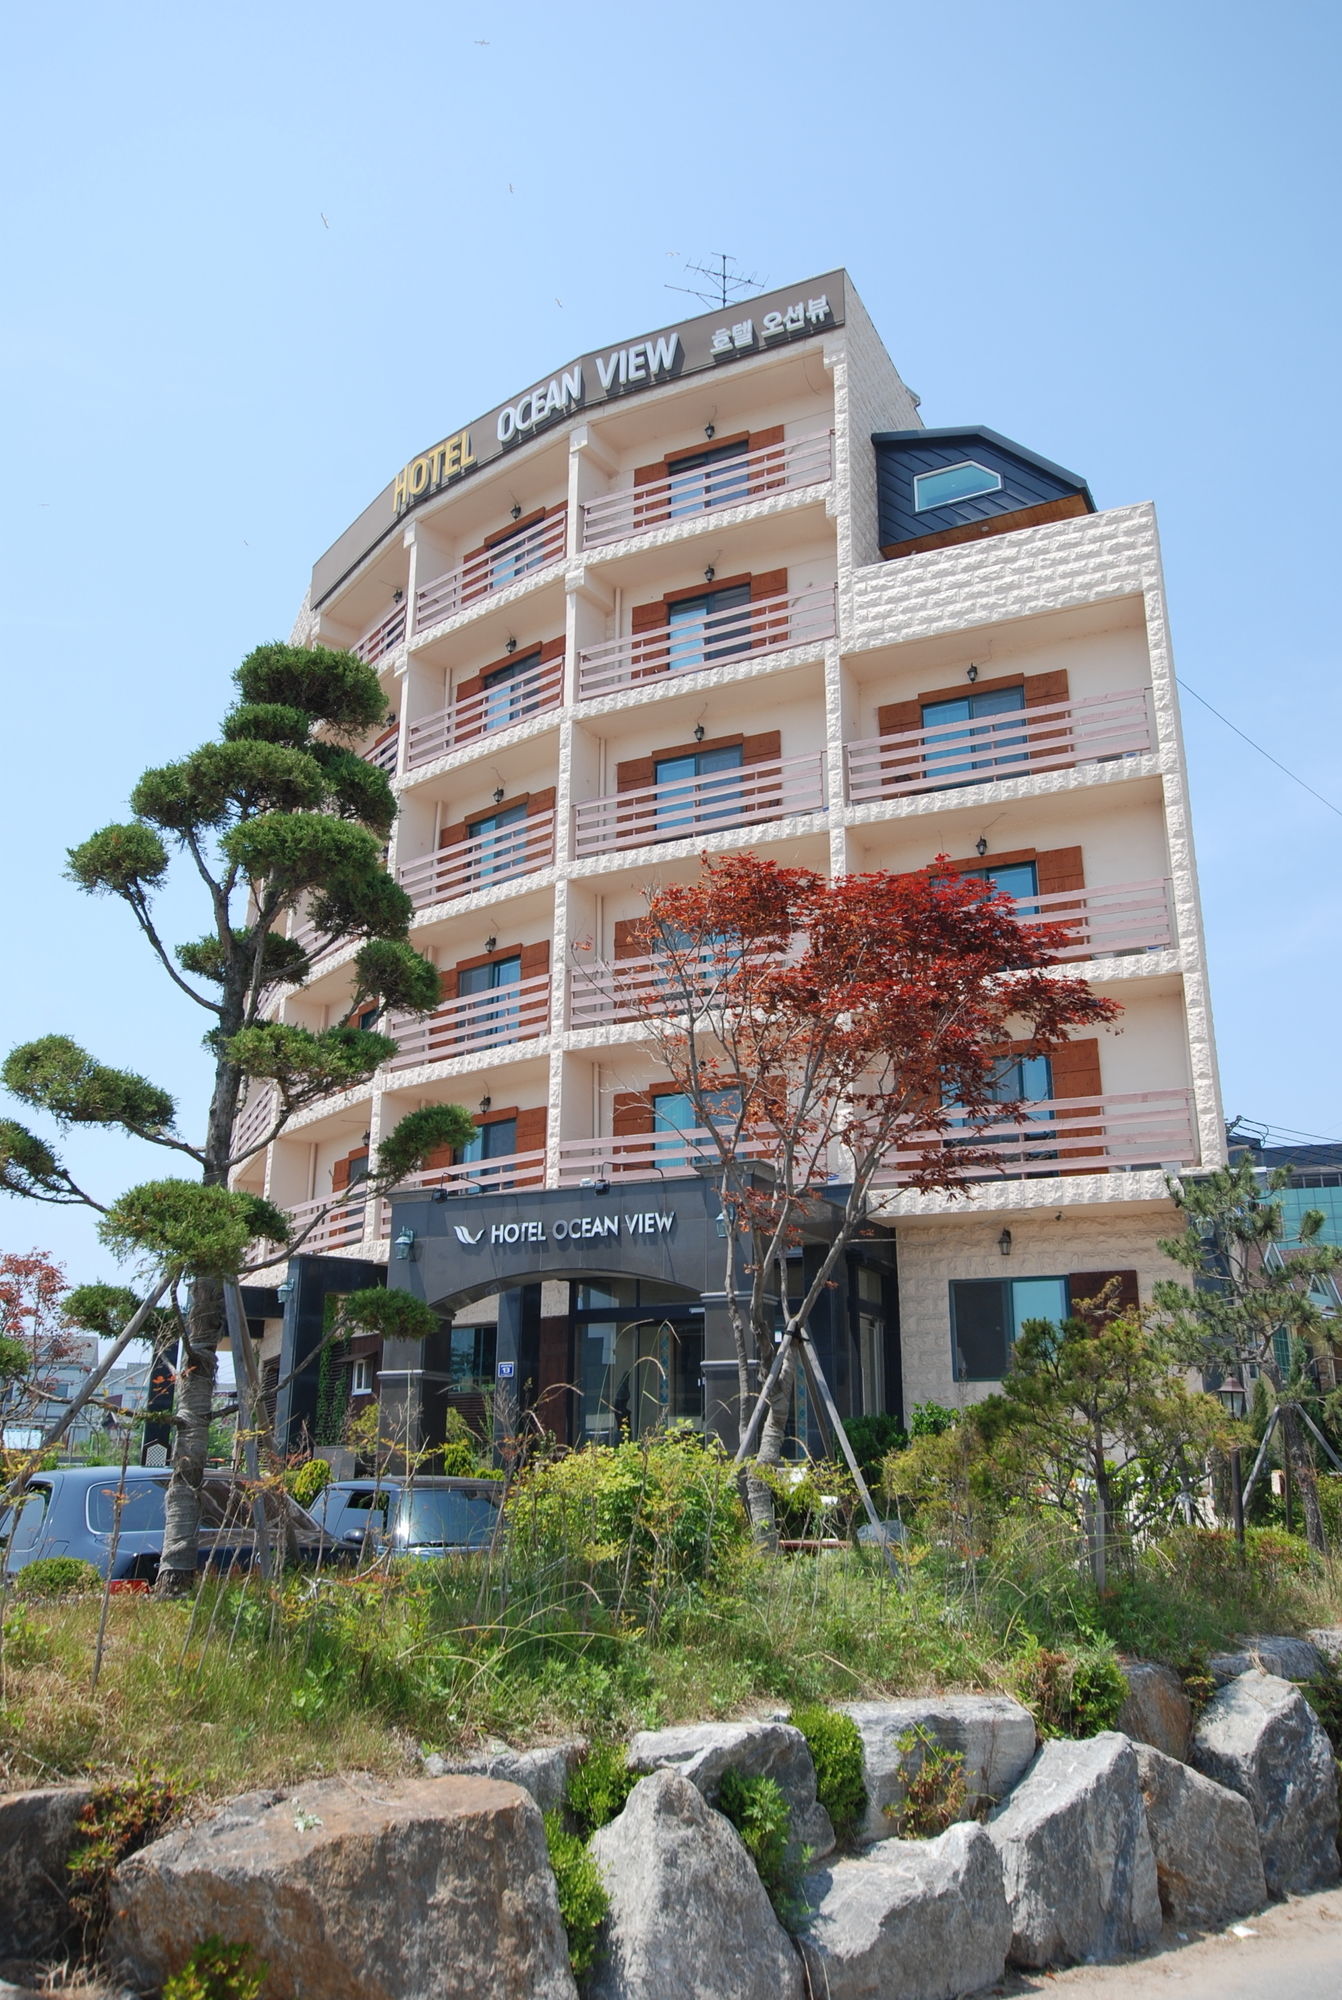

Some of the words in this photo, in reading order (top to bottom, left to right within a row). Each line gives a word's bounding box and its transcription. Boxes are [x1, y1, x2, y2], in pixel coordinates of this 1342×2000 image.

[710, 319, 753, 355] 호텔
[761, 294, 830, 338] 오션뷰
[393, 431, 477, 512] HOTEL
[497, 365, 582, 442] OCEAN
[596, 332, 679, 390] VIEW
[491, 1222, 546, 1244] HOTEL
[552, 1216, 619, 1240] OCEAN
[625, 1211, 675, 1234] VIEW
